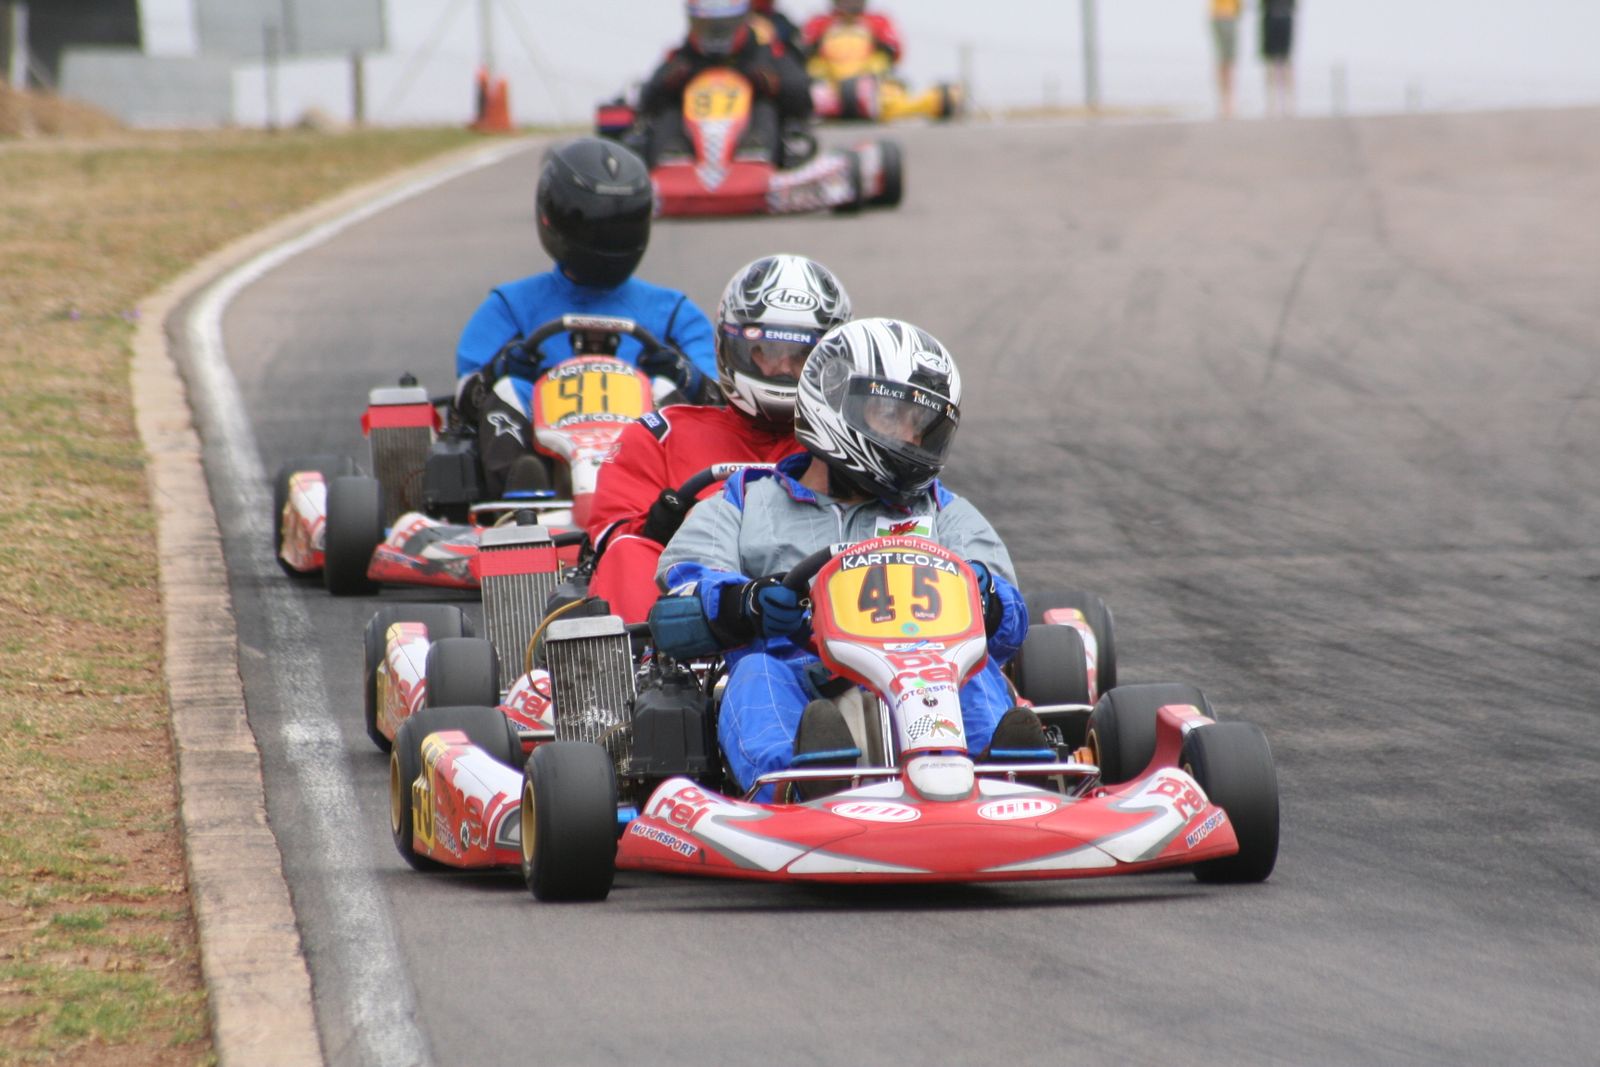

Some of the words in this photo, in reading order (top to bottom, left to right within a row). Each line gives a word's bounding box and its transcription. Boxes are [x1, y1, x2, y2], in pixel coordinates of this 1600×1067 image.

[768, 289, 811, 306] Arai
[765, 330, 811, 343] ENGEN
[842, 553, 893, 570] KART
[902, 553, 958, 576] CO.ZA
[857, 563, 942, 623] 45
[652, 797, 711, 831] rel
[631, 824, 697, 857] MOTORSPORT
